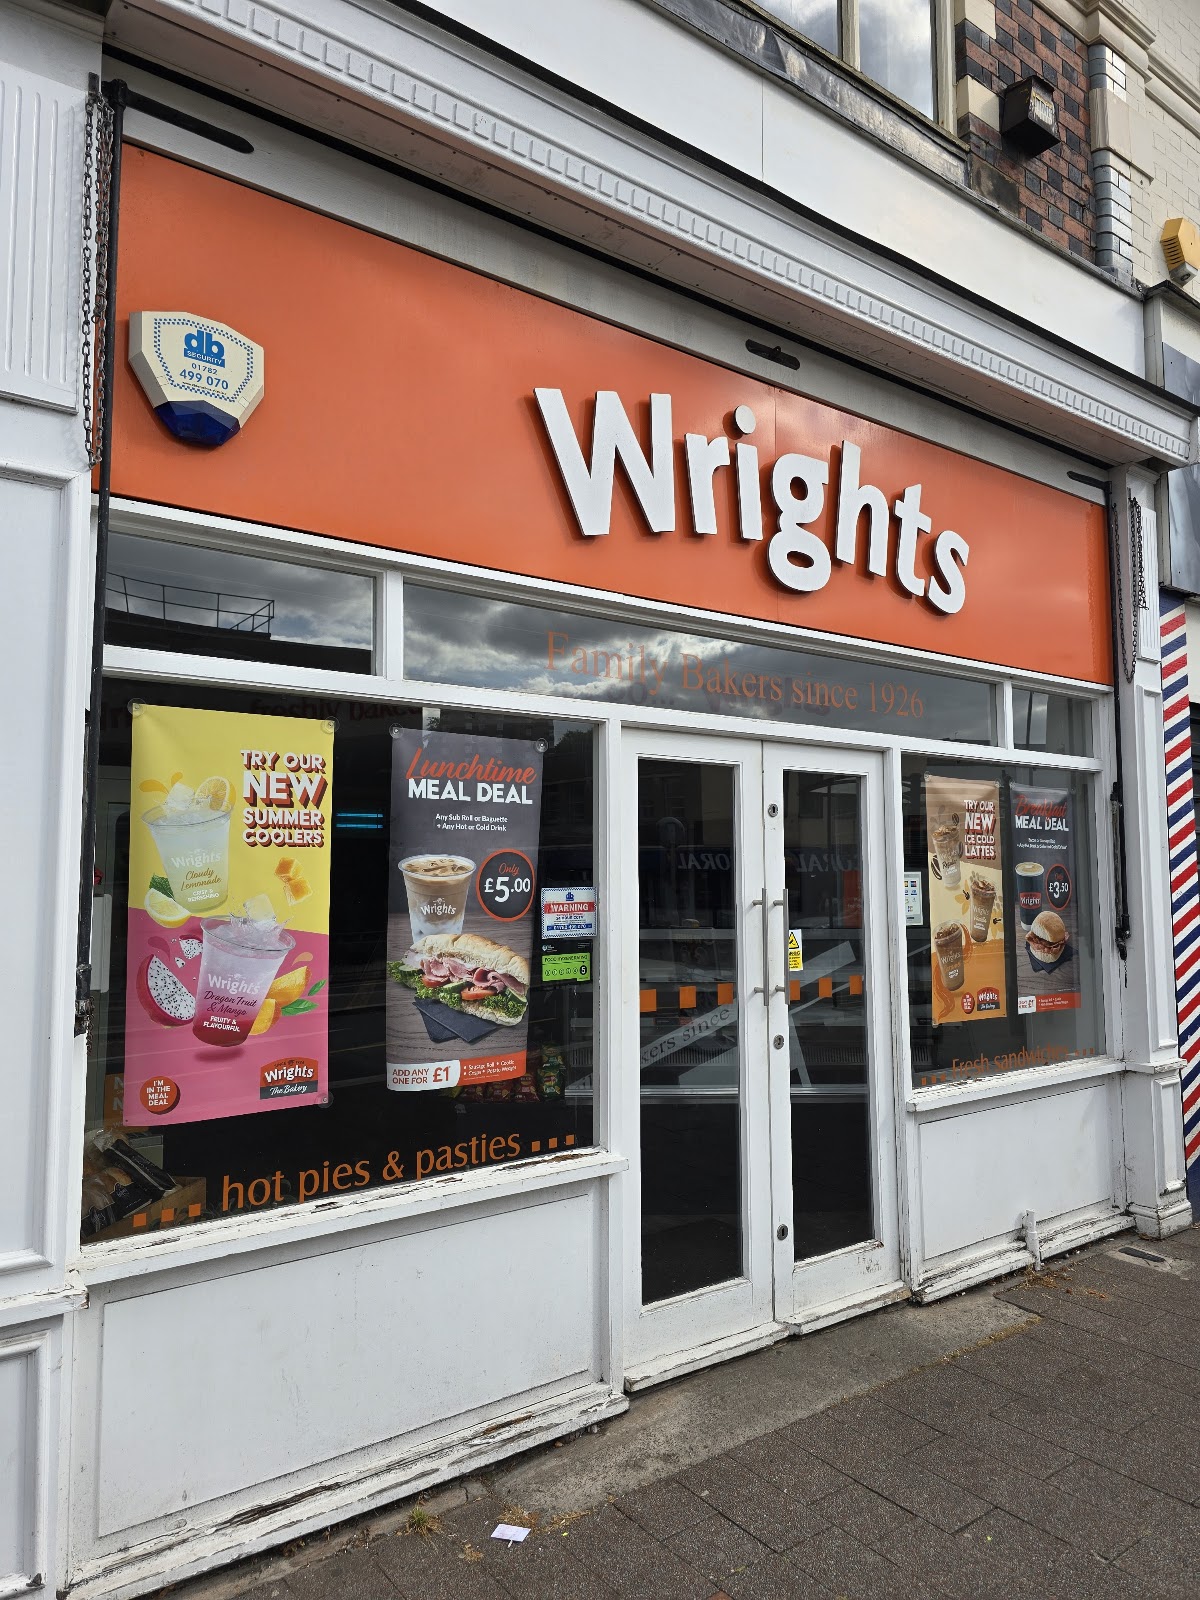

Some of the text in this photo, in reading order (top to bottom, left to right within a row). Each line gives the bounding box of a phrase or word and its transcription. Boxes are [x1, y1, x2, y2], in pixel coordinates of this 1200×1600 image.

[184, 329, 224, 358] db
[187, 350, 222, 365] SECURITY
[191, 362, 217, 374] 01782
[180, 369, 202, 382] 499
[206, 376, 229, 390] 070
[533, 387, 970, 614] Wrights
[544, 630, 668, 696] Family
[680, 652, 783, 702] Bakers
[792, 672, 858, 711] since
[869, 680, 924, 718] 1926
[240, 749, 326, 773] TRY OUR
[405, 747, 537, 784] Lunchtime
[243, 770, 328, 808] NEW
[408, 778, 533, 805] MEAL DEAL
[964, 799, 995, 813] TRY OUR
[1015, 794, 1067, 817] Breakfast
[243, 808, 324, 829] SUMMER
[435, 813, 448, 821] Any
[448, 813, 461, 821] Sub
[481, 815, 508, 823] Baguette
[442, 822, 454, 830] Any
[964, 812, 996, 834] NEW
[1015, 815, 1069, 831] MEAL DEAL
[243, 829, 324, 847] COOLERS
[965, 834, 995, 846] ICE COLD
[171, 852, 222, 868] Wrights
[965, 845, 996, 859] LATTES
[186, 868, 214, 880] Cloudy
[498, 862, 519, 876] Only
[181, 875, 222, 891] Lemonade
[484, 876, 530, 902] £5.00
[1049, 881, 1069, 898] £3.50
[420, 902, 457, 916] Wrights
[551, 903, 589, 912] WARNING
[208, 974, 261, 995] Wrights
[204, 990, 257, 1008] Dragon Fruit
[207, 1002, 247, 1017] & Mango
[203, 1021, 240, 1032] FLAVOURFUL
[210, 1015, 231, 1024] FRUITY
[682, 1008, 730, 1041] since
[264, 1065, 314, 1082] Wrights
[392, 1068, 429, 1077] ADD ANY
[952, 1053, 990, 1079] Fresh
[392, 1076, 428, 1085] ONE FOR
[148, 1092, 169, 1100] MEAL
[270, 1083, 308, 1095] The Bakery
[222, 1132, 521, 1212] hot pies & pasties
